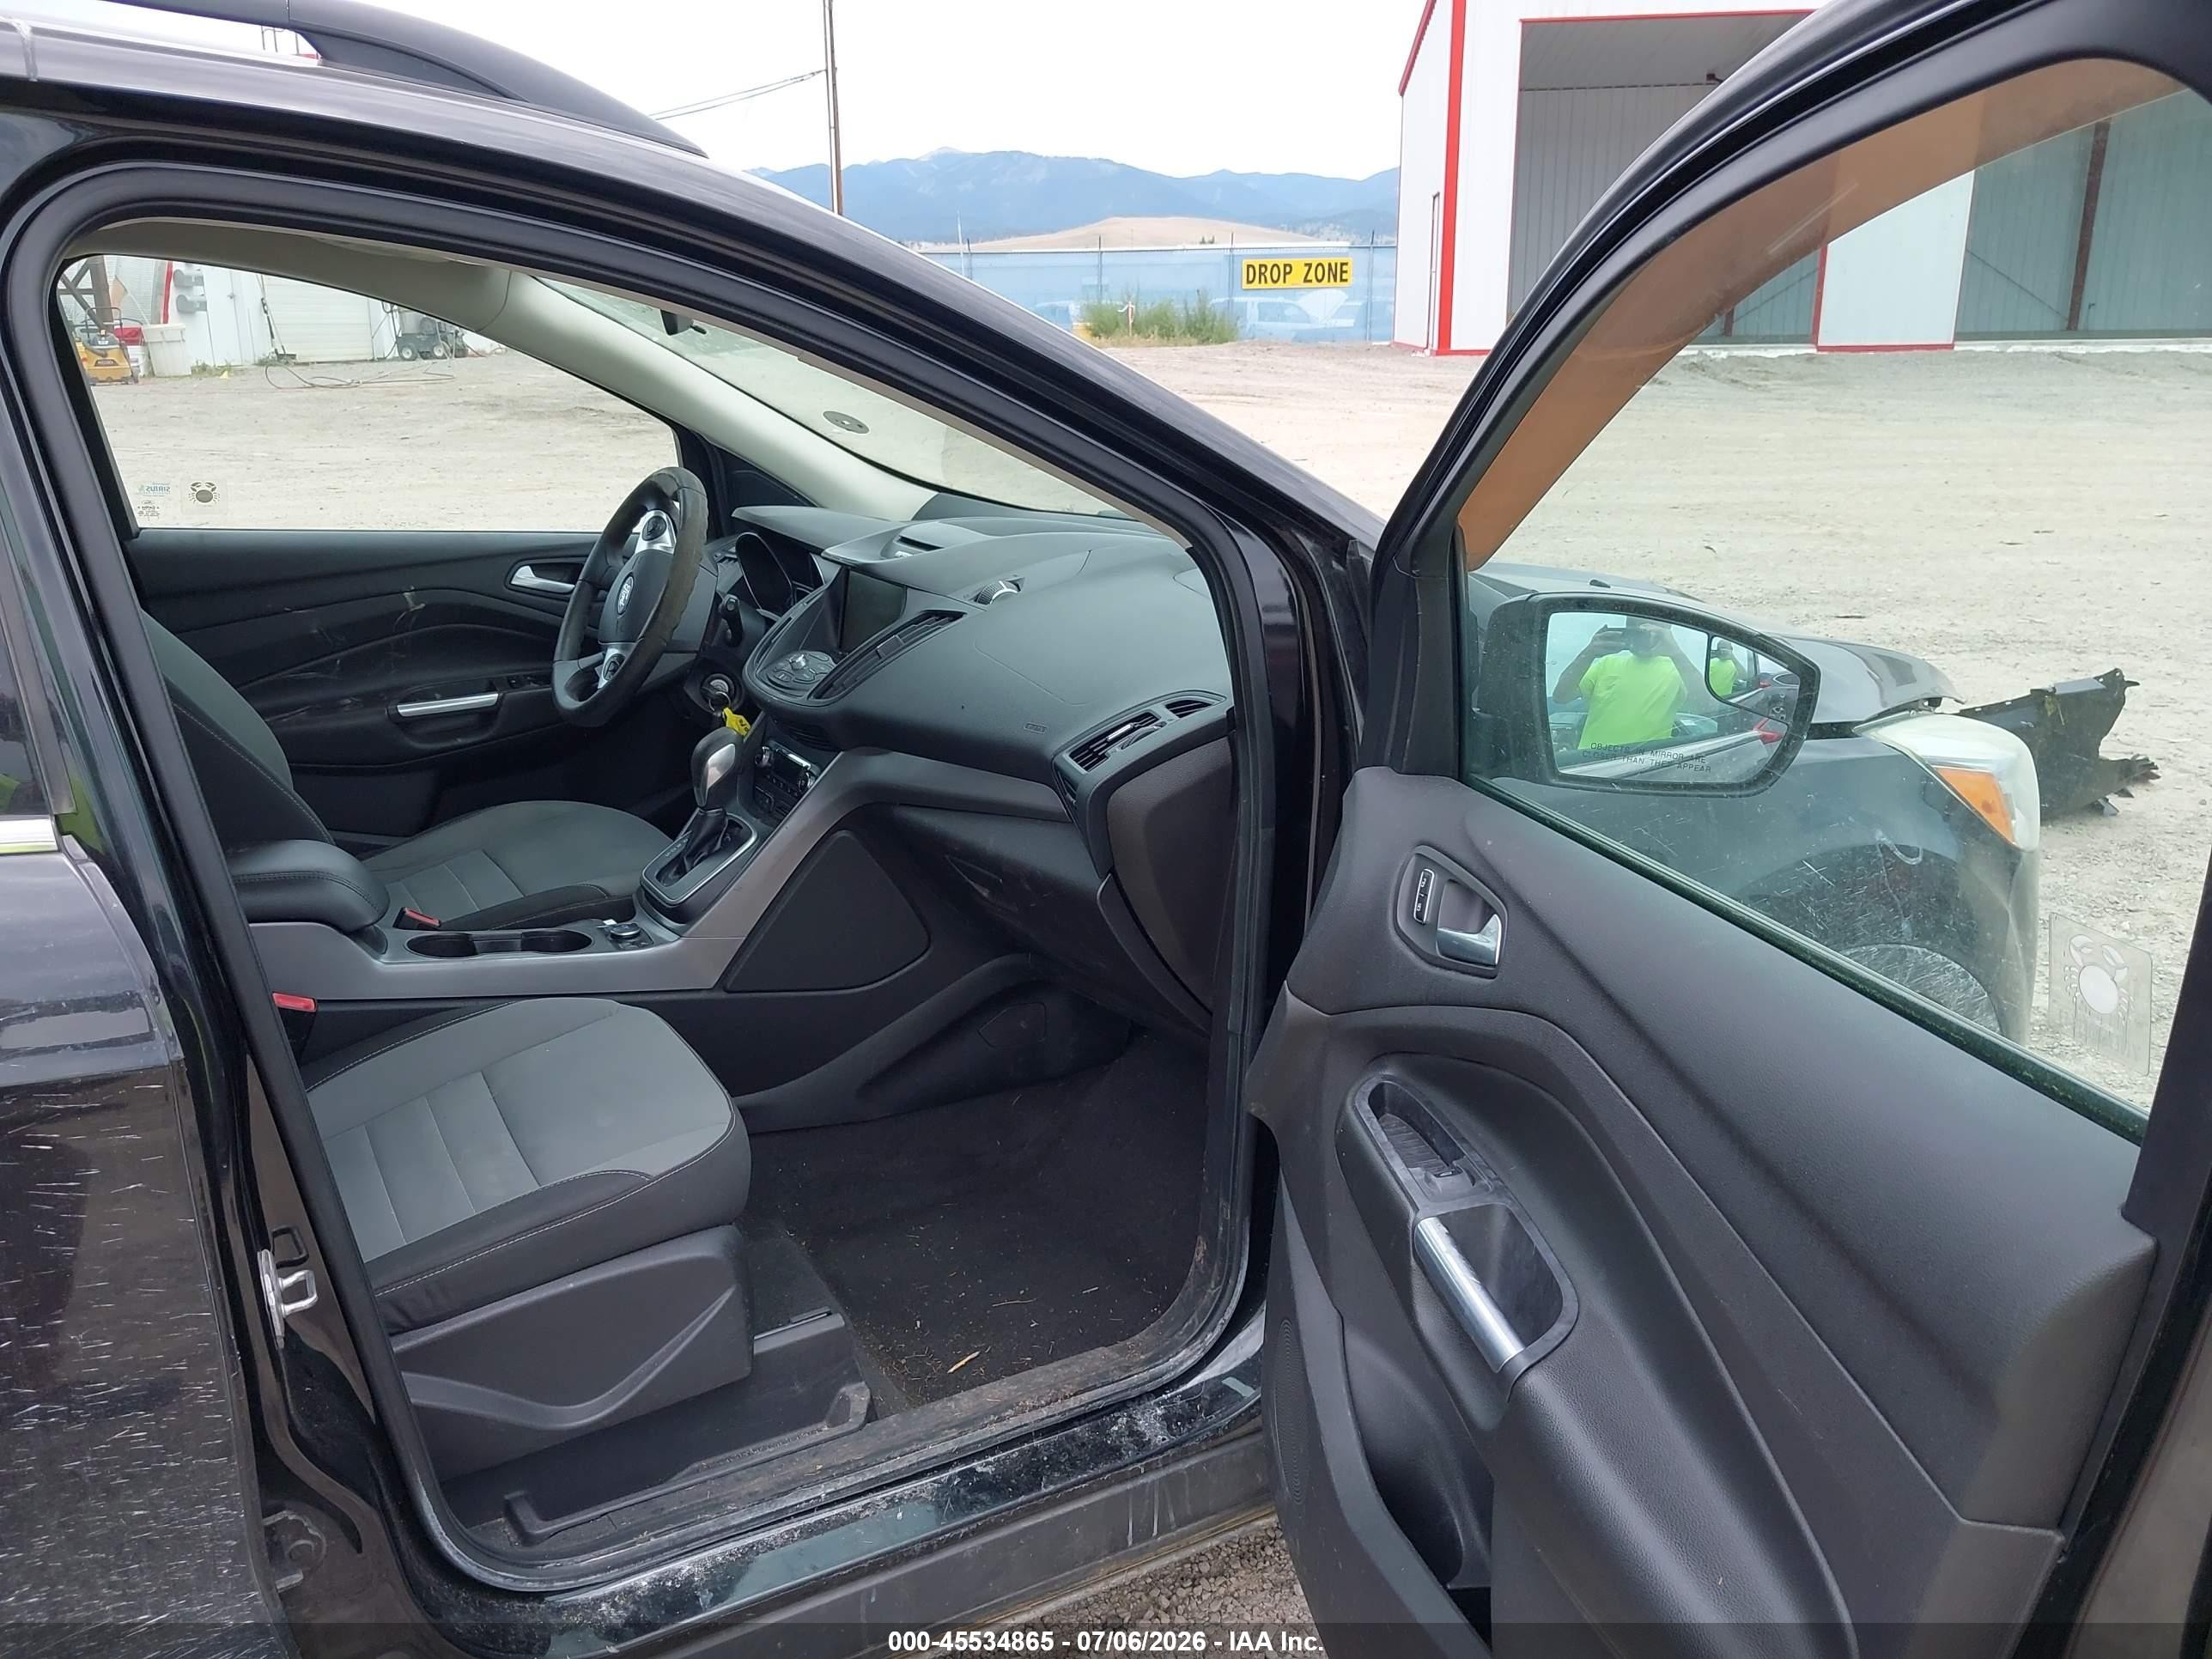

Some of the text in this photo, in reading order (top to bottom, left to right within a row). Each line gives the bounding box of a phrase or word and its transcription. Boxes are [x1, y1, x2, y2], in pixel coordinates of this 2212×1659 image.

[1246, 262, 1349, 284] DROP ZONE
[1590, 742, 1631, 753] OBJECTS
[1650, 750, 1685, 761] MIRROR
[1690, 754, 1706, 763] ARE
[1621, 757, 1645, 765] THAN
[1677, 763, 1711, 773] APPEAR
